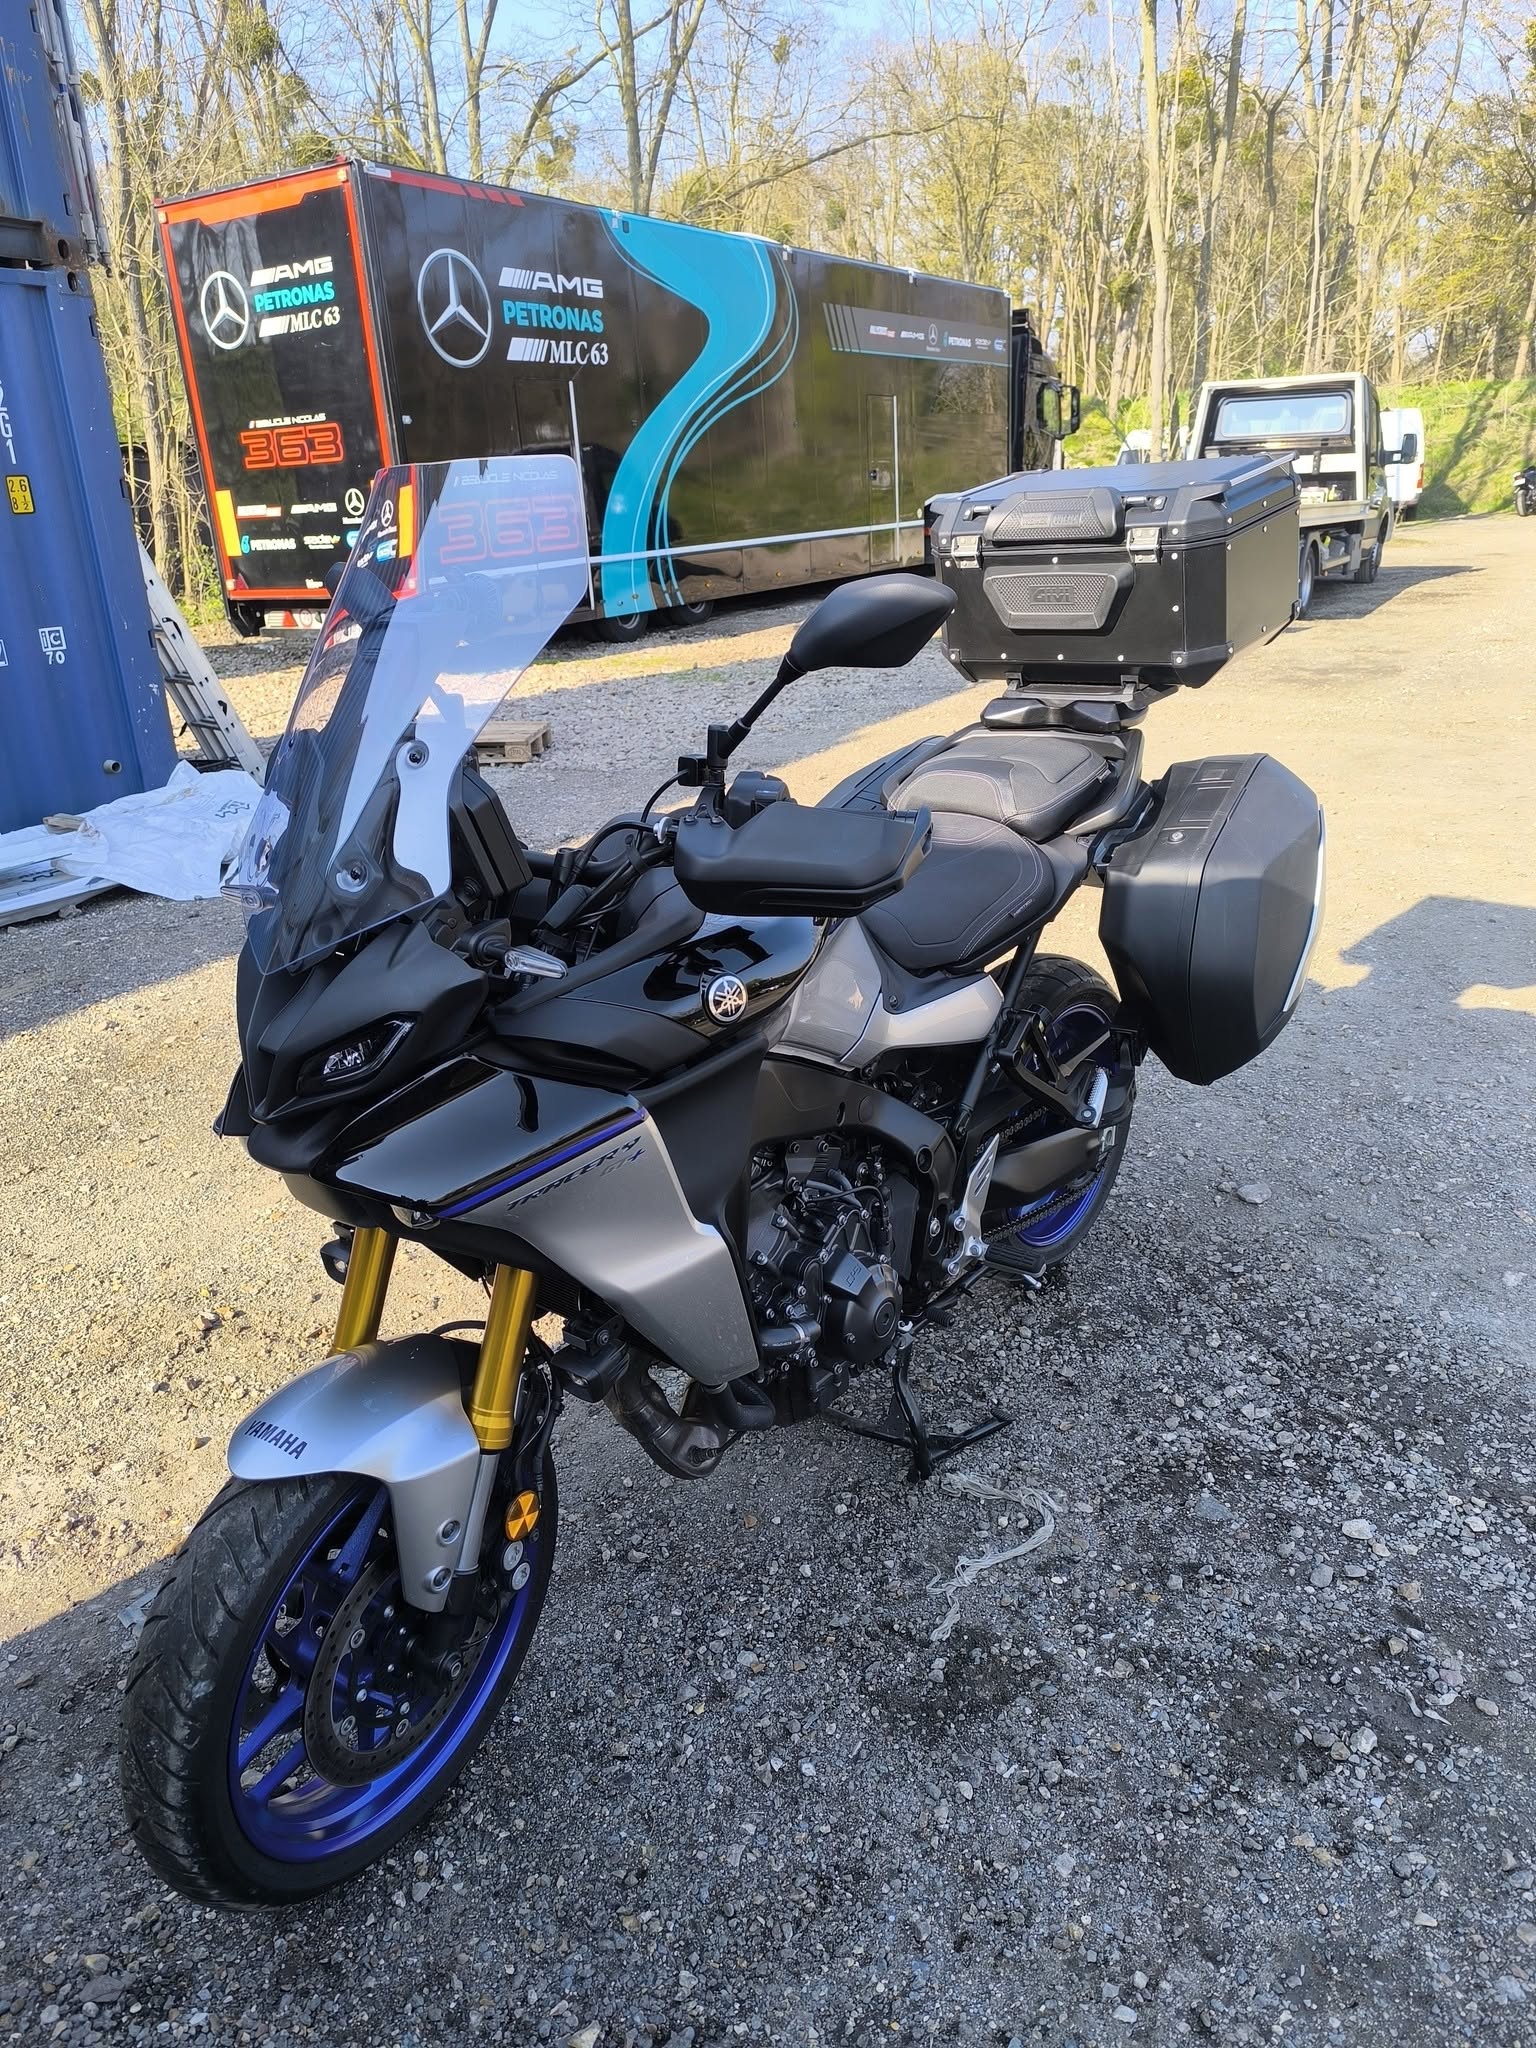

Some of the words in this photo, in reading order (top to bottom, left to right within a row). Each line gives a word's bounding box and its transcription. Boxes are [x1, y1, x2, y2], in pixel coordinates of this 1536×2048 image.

[254, 281, 335, 312] PETRONAS
[531, 271, 604, 299] AMG
[289, 311, 322, 334] MLC
[323, 306, 341, 327] 63
[502, 299, 604, 334] PETRONAS
[548, 340, 591, 365] MLC
[590, 342, 609, 366] 63
[240, 422, 344, 470] 363
[8, 479, 28, 494] 2.6
[438, 494, 580, 566] 363
[250, 538, 297, 551] PETRONAS
[46, 651, 66, 665] 70
[244, 1419, 308, 1460] YAMAHA
